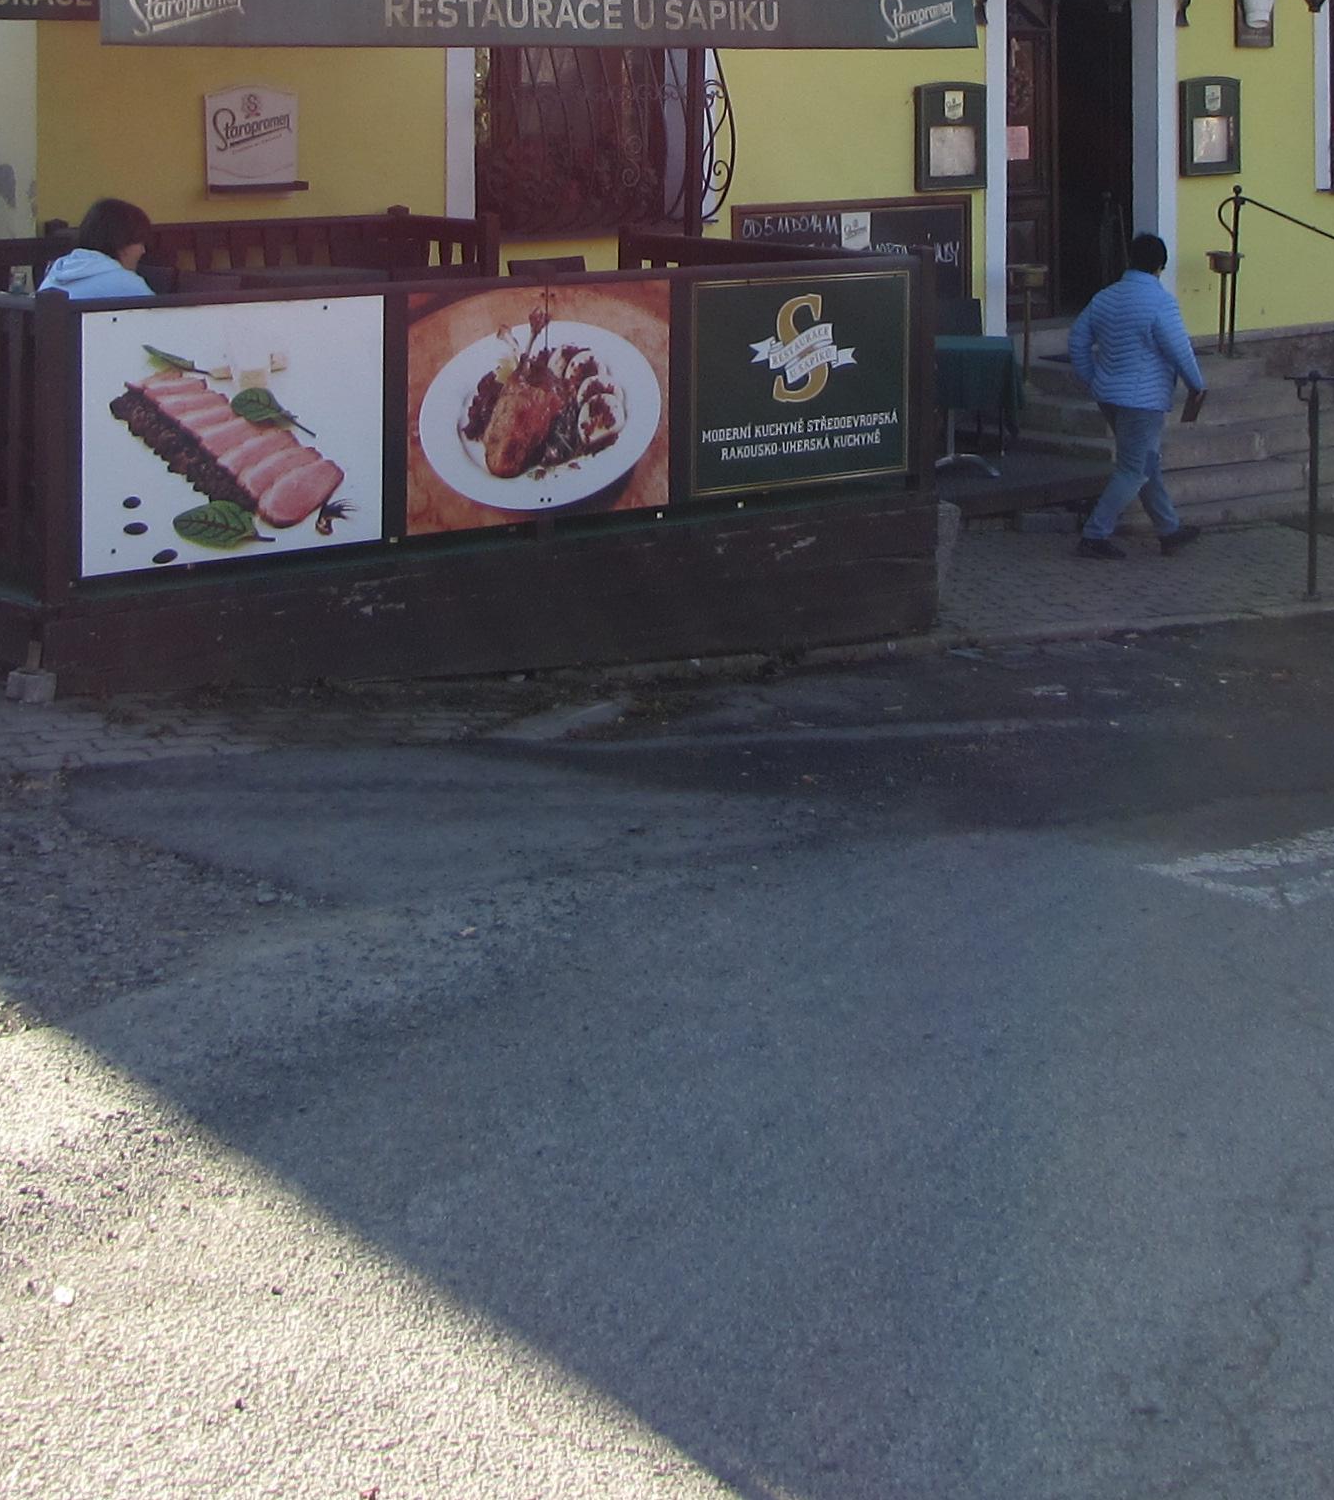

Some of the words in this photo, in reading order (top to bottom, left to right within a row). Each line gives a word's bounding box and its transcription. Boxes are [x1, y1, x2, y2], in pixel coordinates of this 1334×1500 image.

[212, 107, 293, 152] Staropramen
[702, 422, 752, 443] MODERNÍ
[807, 407, 899, 433] STŘEDOEVROPSKÁ
